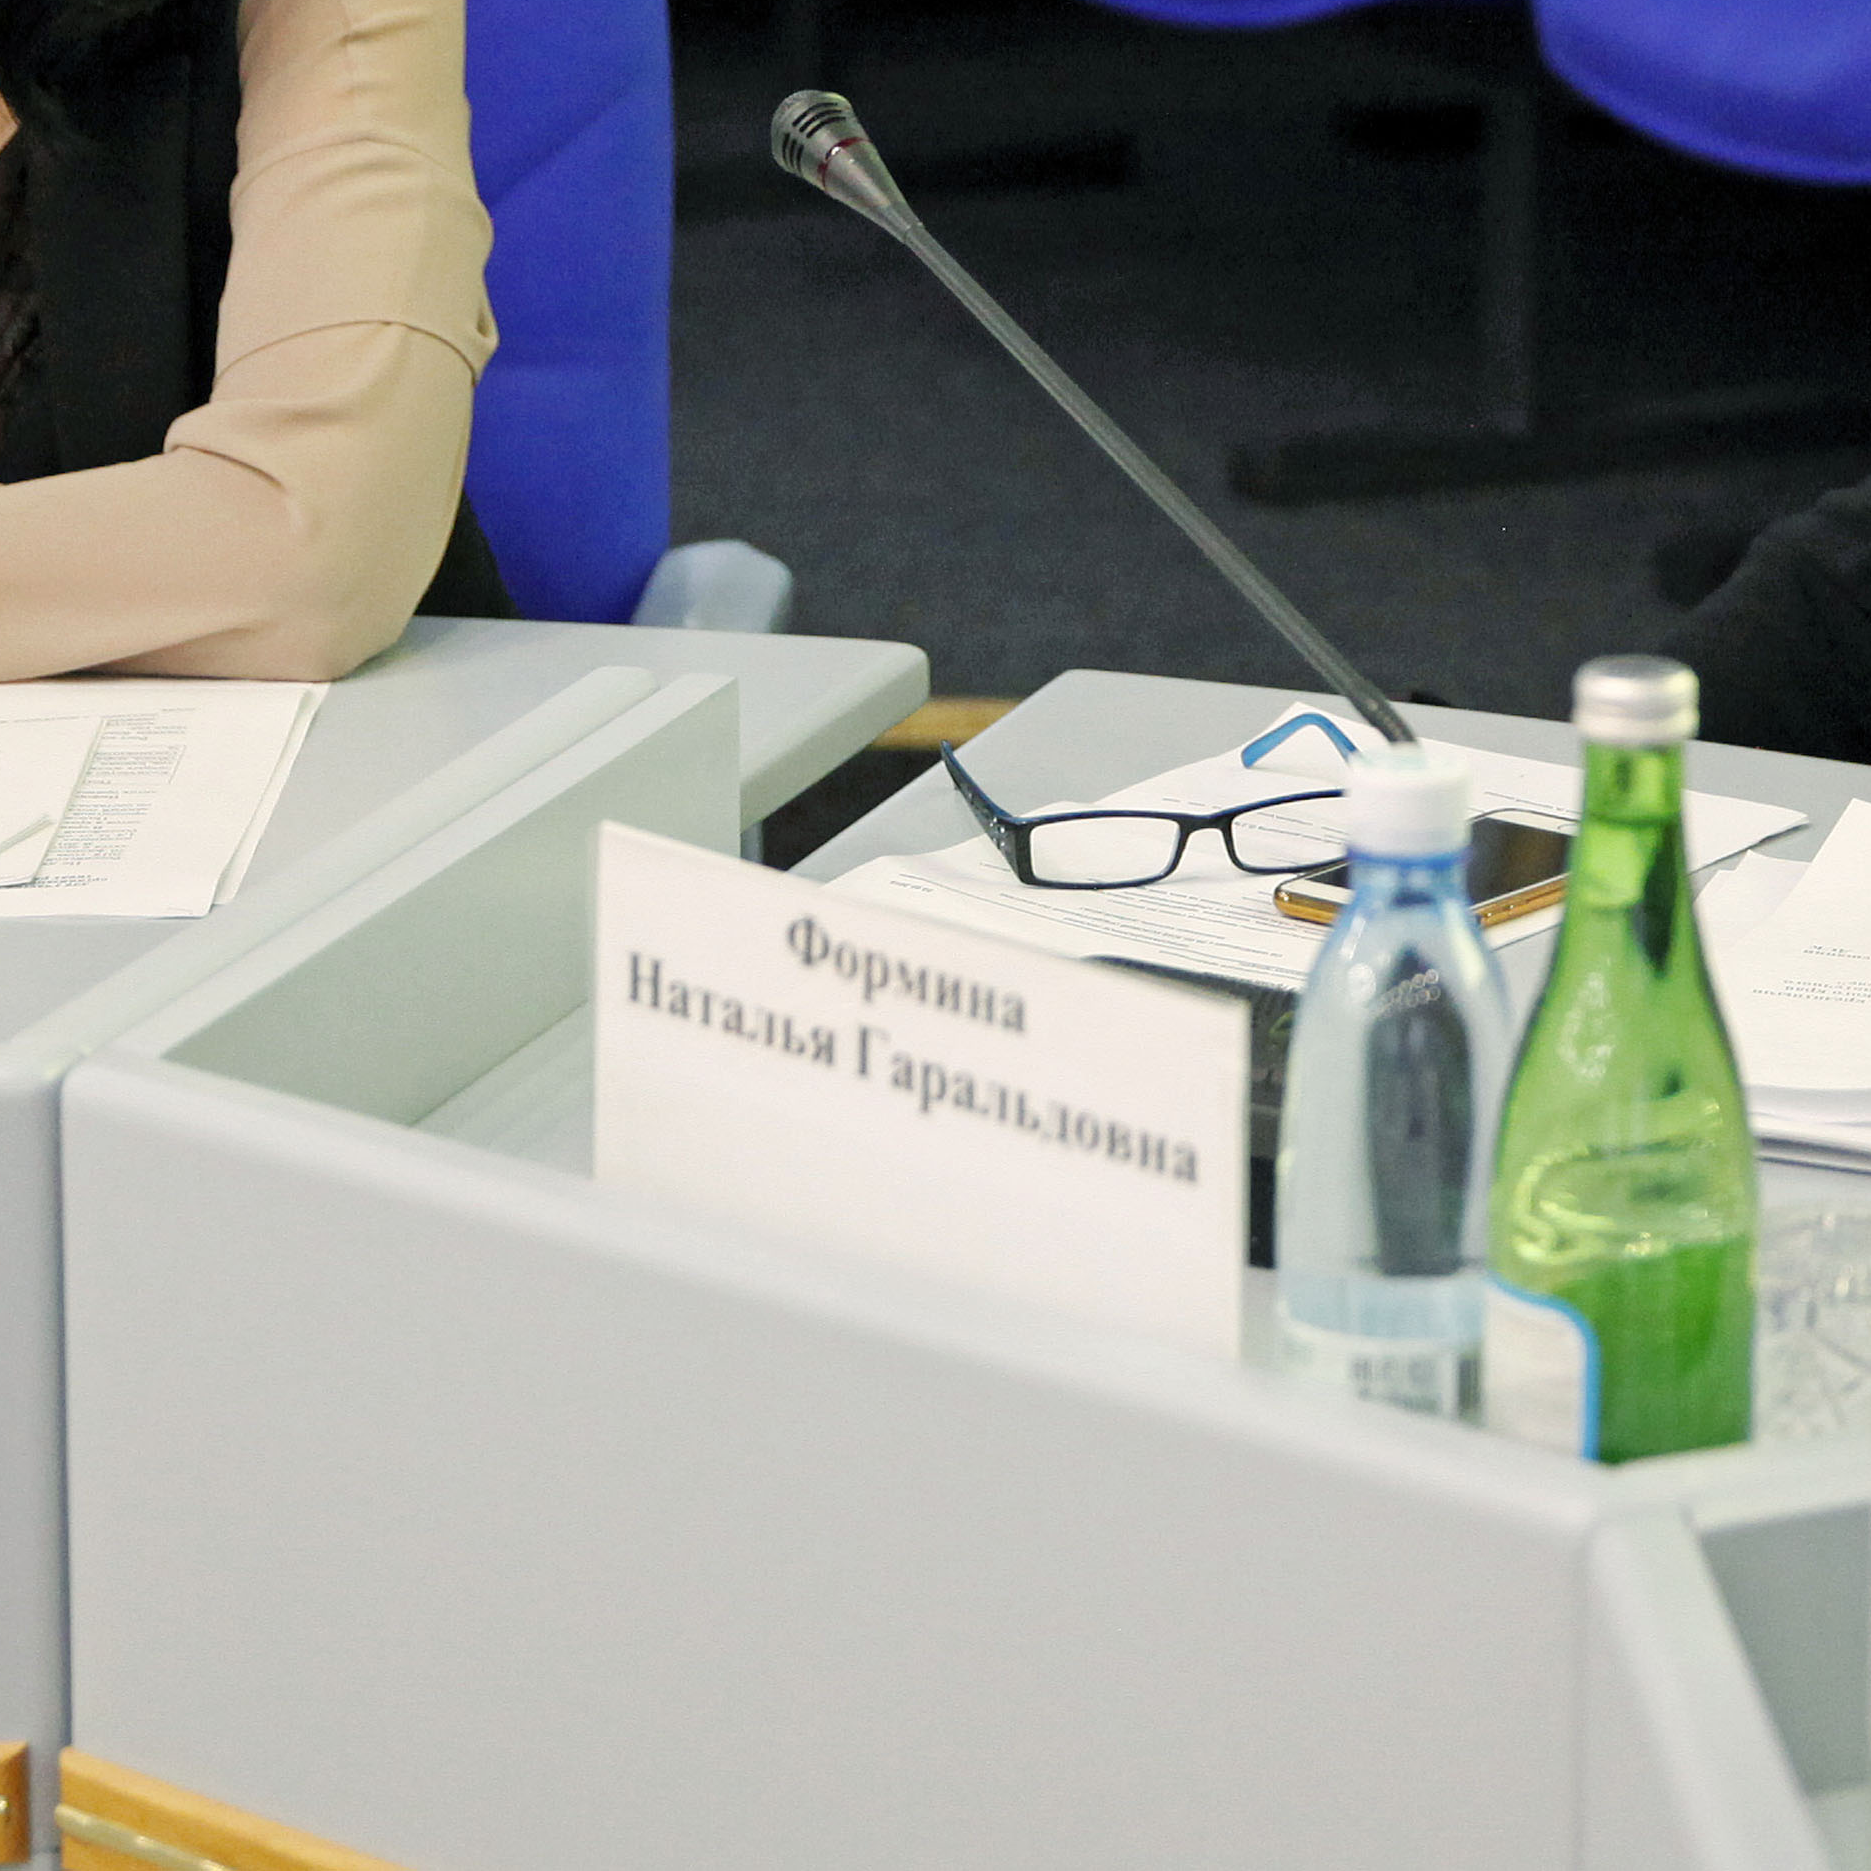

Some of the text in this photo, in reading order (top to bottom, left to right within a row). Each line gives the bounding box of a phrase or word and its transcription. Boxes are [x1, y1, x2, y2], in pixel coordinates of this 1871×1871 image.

[787, 915, 1025, 1032] Формина
[628, 953, 1197, 1182] Наталья Гаральдовна
